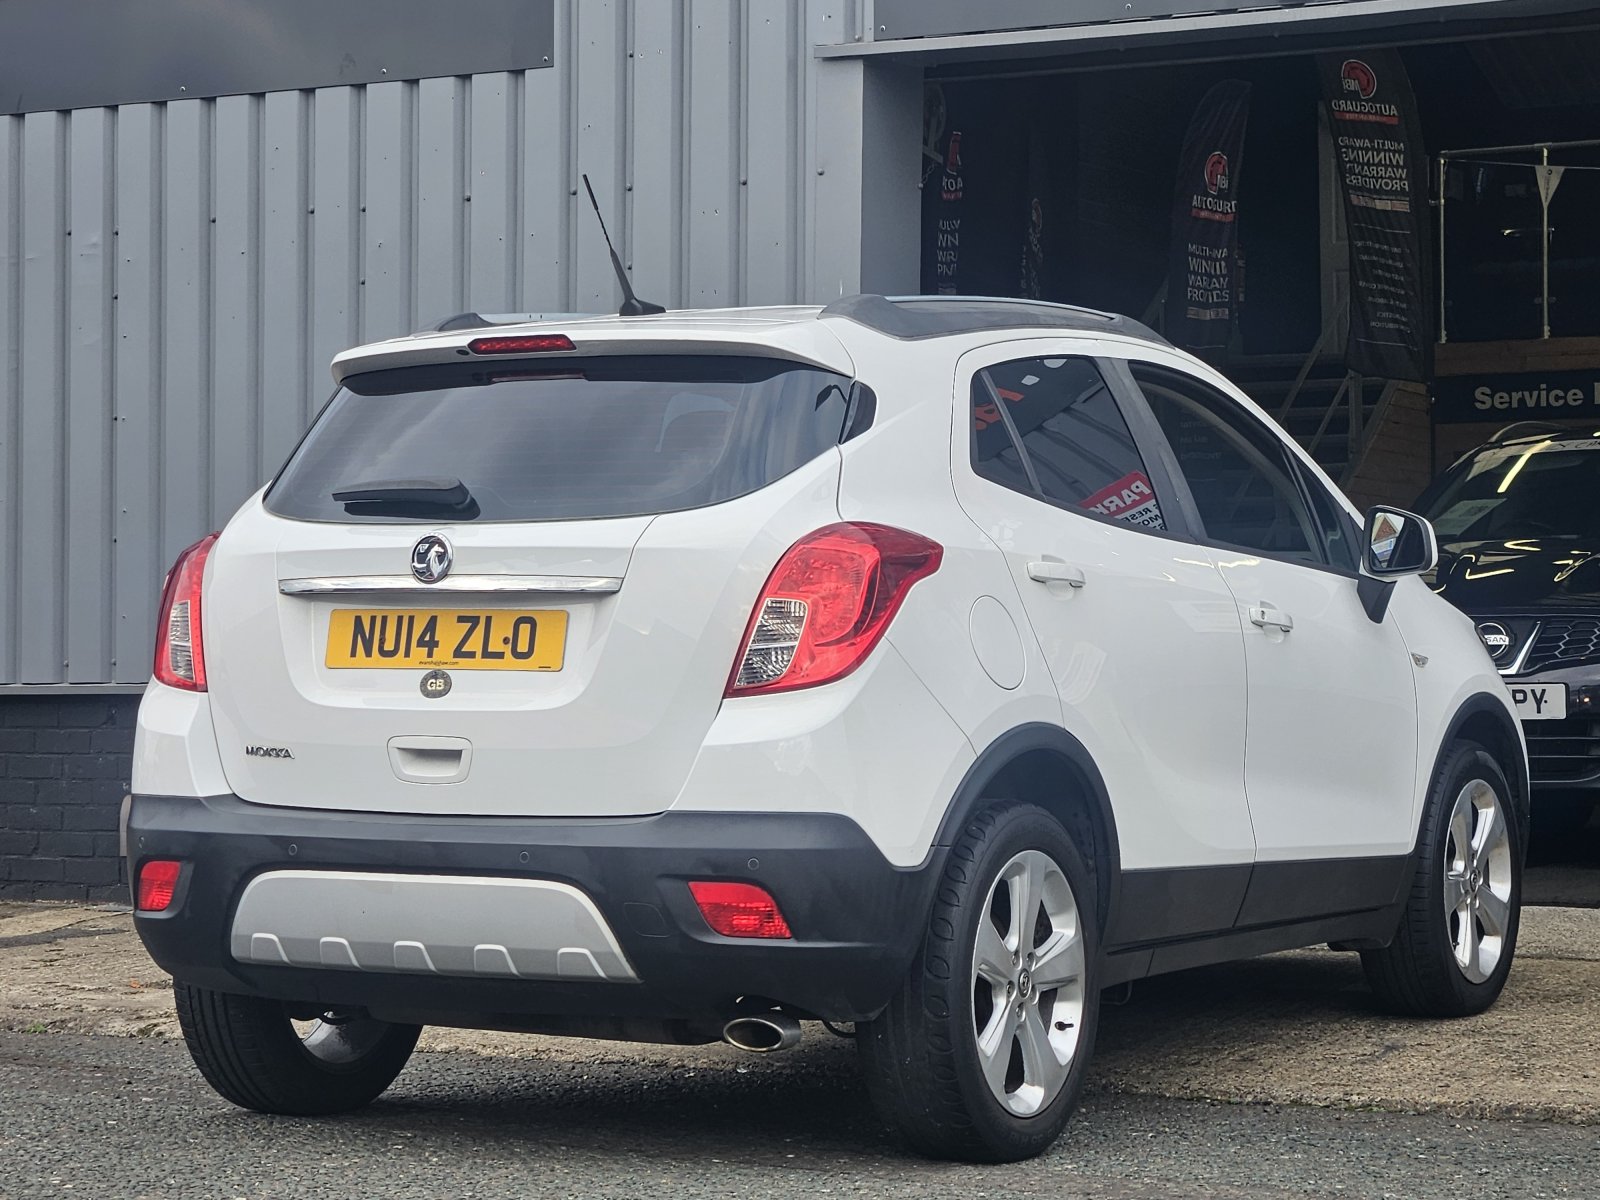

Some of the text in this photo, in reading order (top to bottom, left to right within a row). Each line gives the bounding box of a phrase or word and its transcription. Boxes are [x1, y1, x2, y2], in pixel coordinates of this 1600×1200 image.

[1474, 383, 1584, 410] Service
[350, 615, 537, 660] NU14 ZLO
[427, 679, 445, 691] GB
[246, 746, 295, 759] MOKKA
